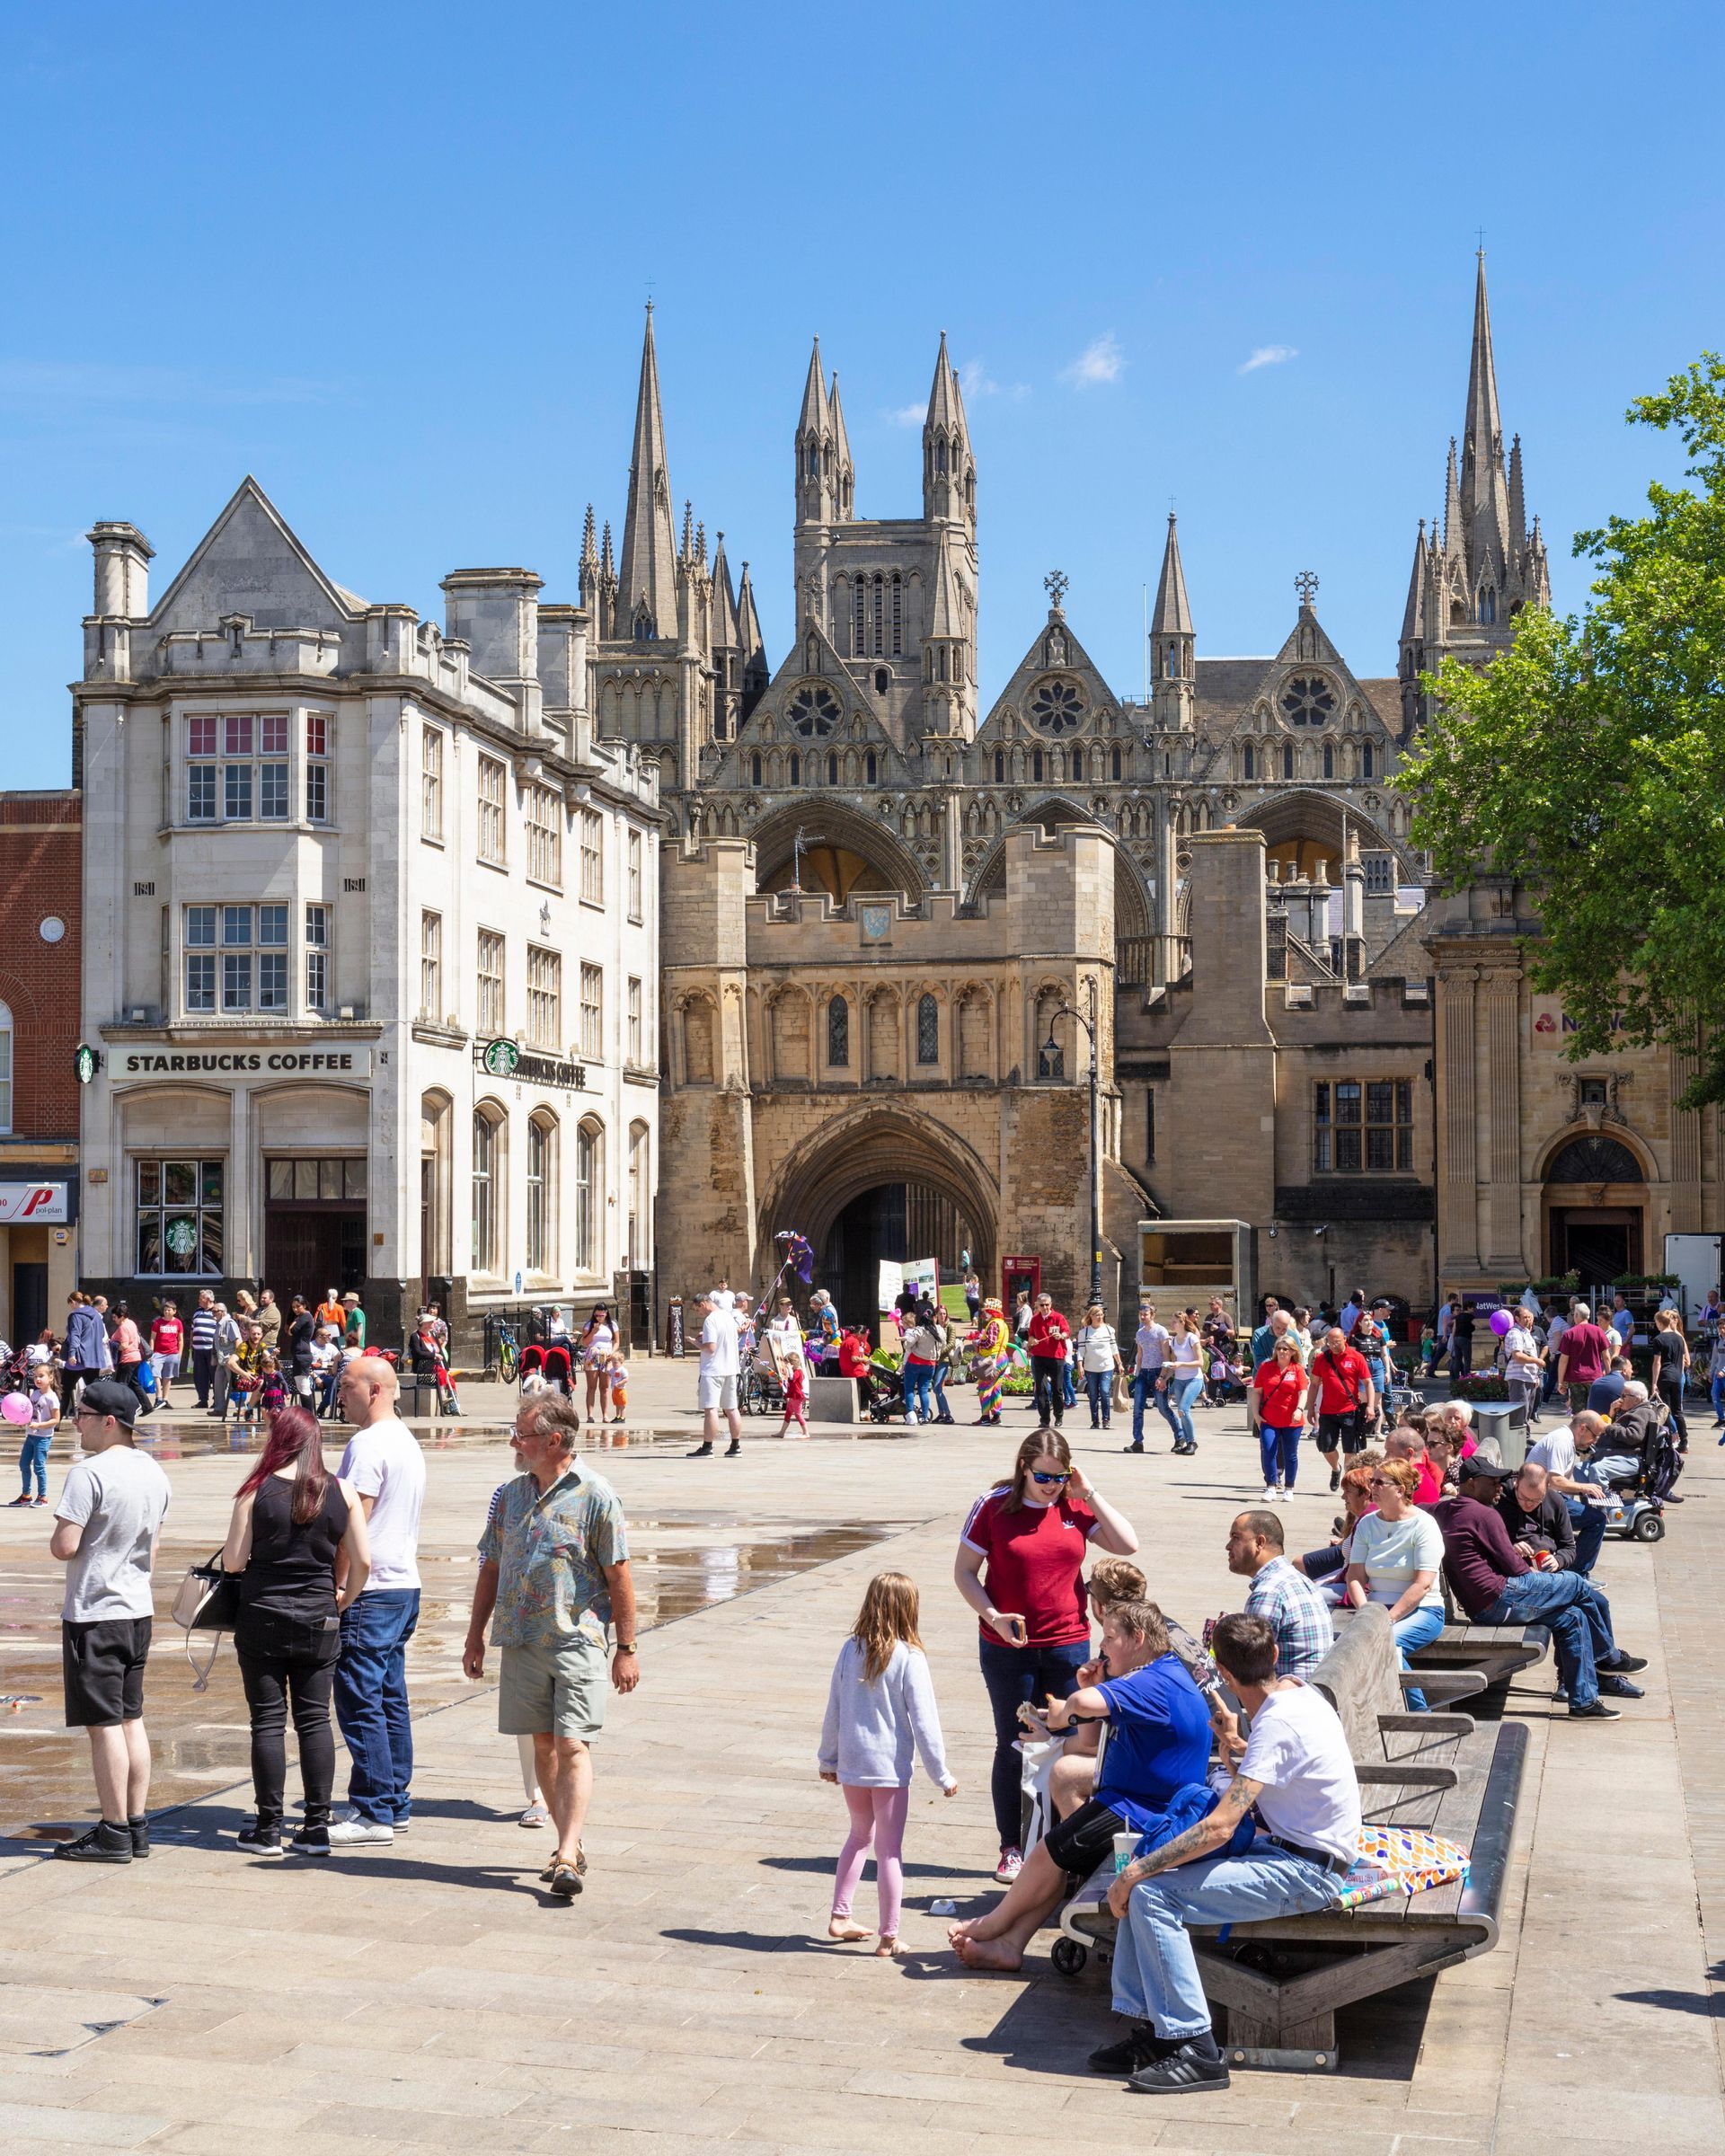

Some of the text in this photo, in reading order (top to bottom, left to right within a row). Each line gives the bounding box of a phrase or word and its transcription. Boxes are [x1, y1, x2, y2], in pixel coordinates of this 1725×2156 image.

[127, 1054, 352, 1072] STARBUCKS COFFEE
[513, 1054, 586, 1087] ARBUCKS COFFEE
